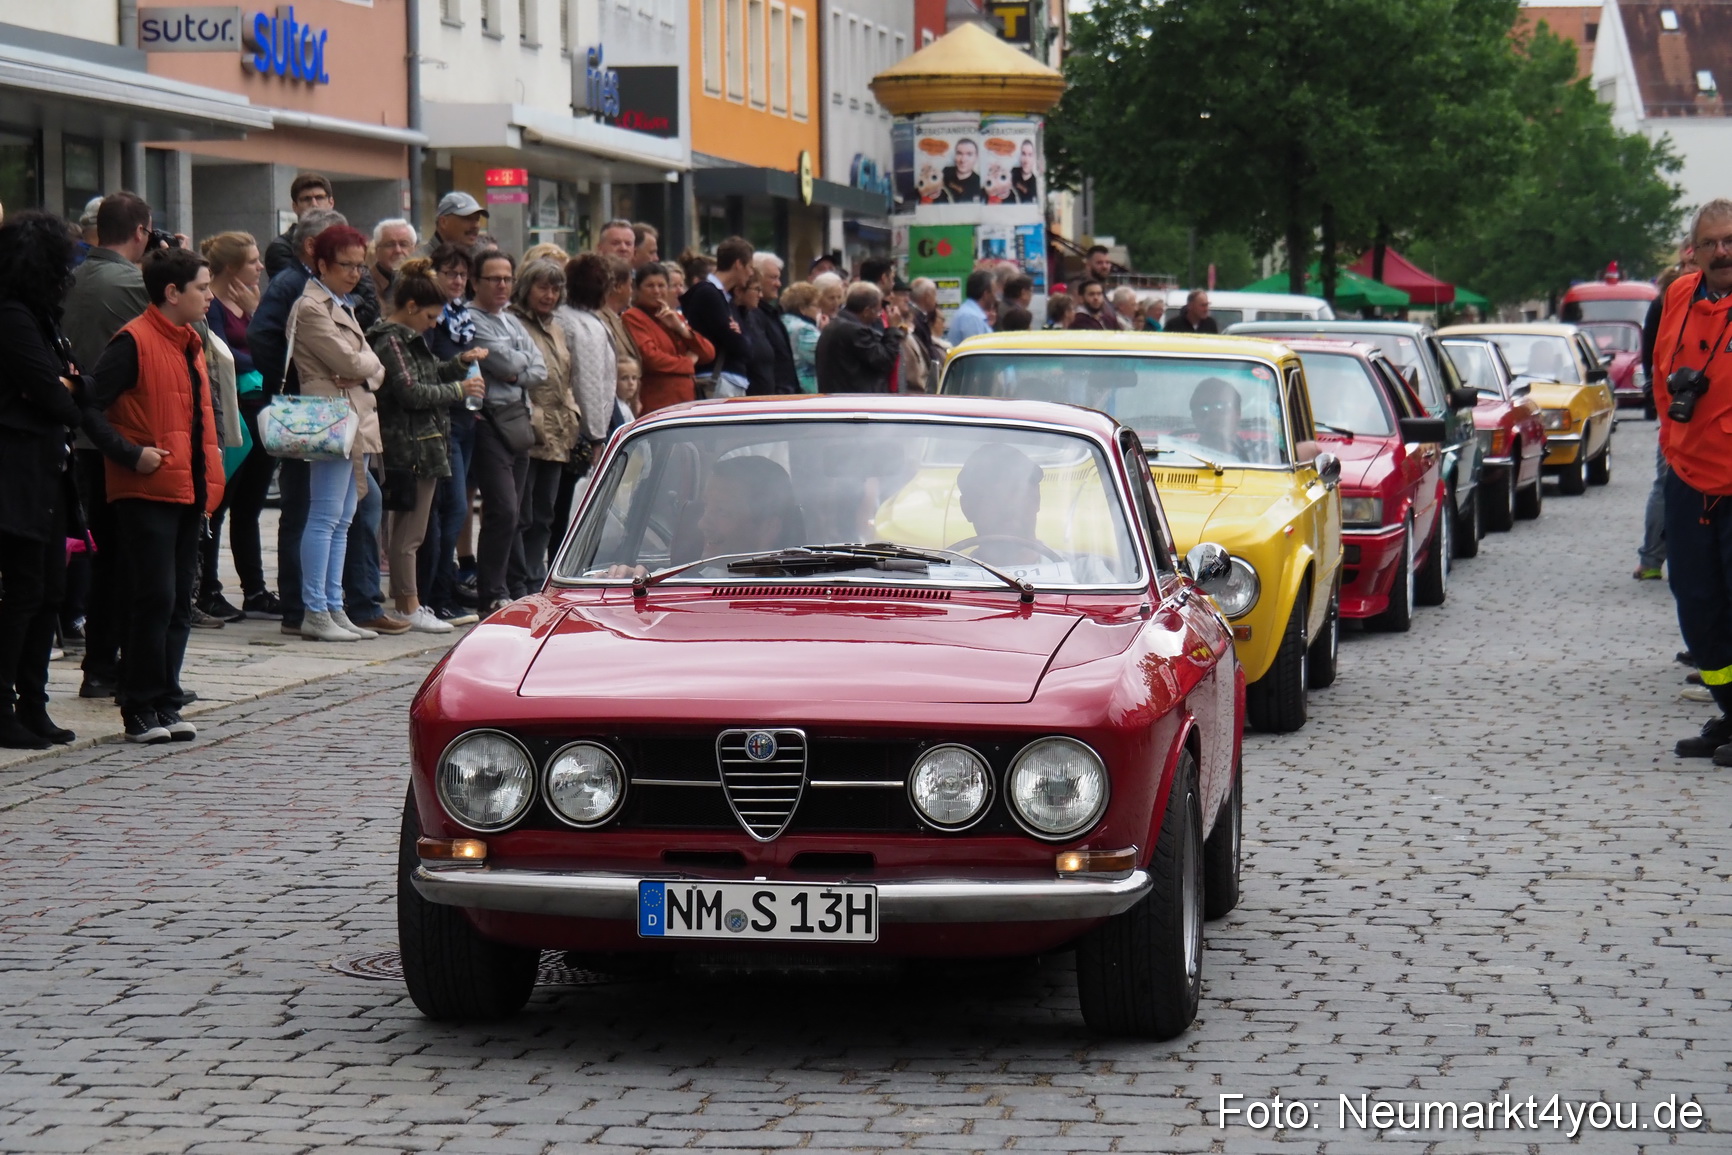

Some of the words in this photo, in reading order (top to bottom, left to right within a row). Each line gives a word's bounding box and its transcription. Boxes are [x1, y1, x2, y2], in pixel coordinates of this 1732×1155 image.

[142, 14, 235, 43] sutor.
[254, 5, 329, 85] sutor.
[648, 914, 657, 926] D
[667, 889, 723, 931] NM
[751, 890, 777, 932] S
[790, 892, 873, 934] 13H
